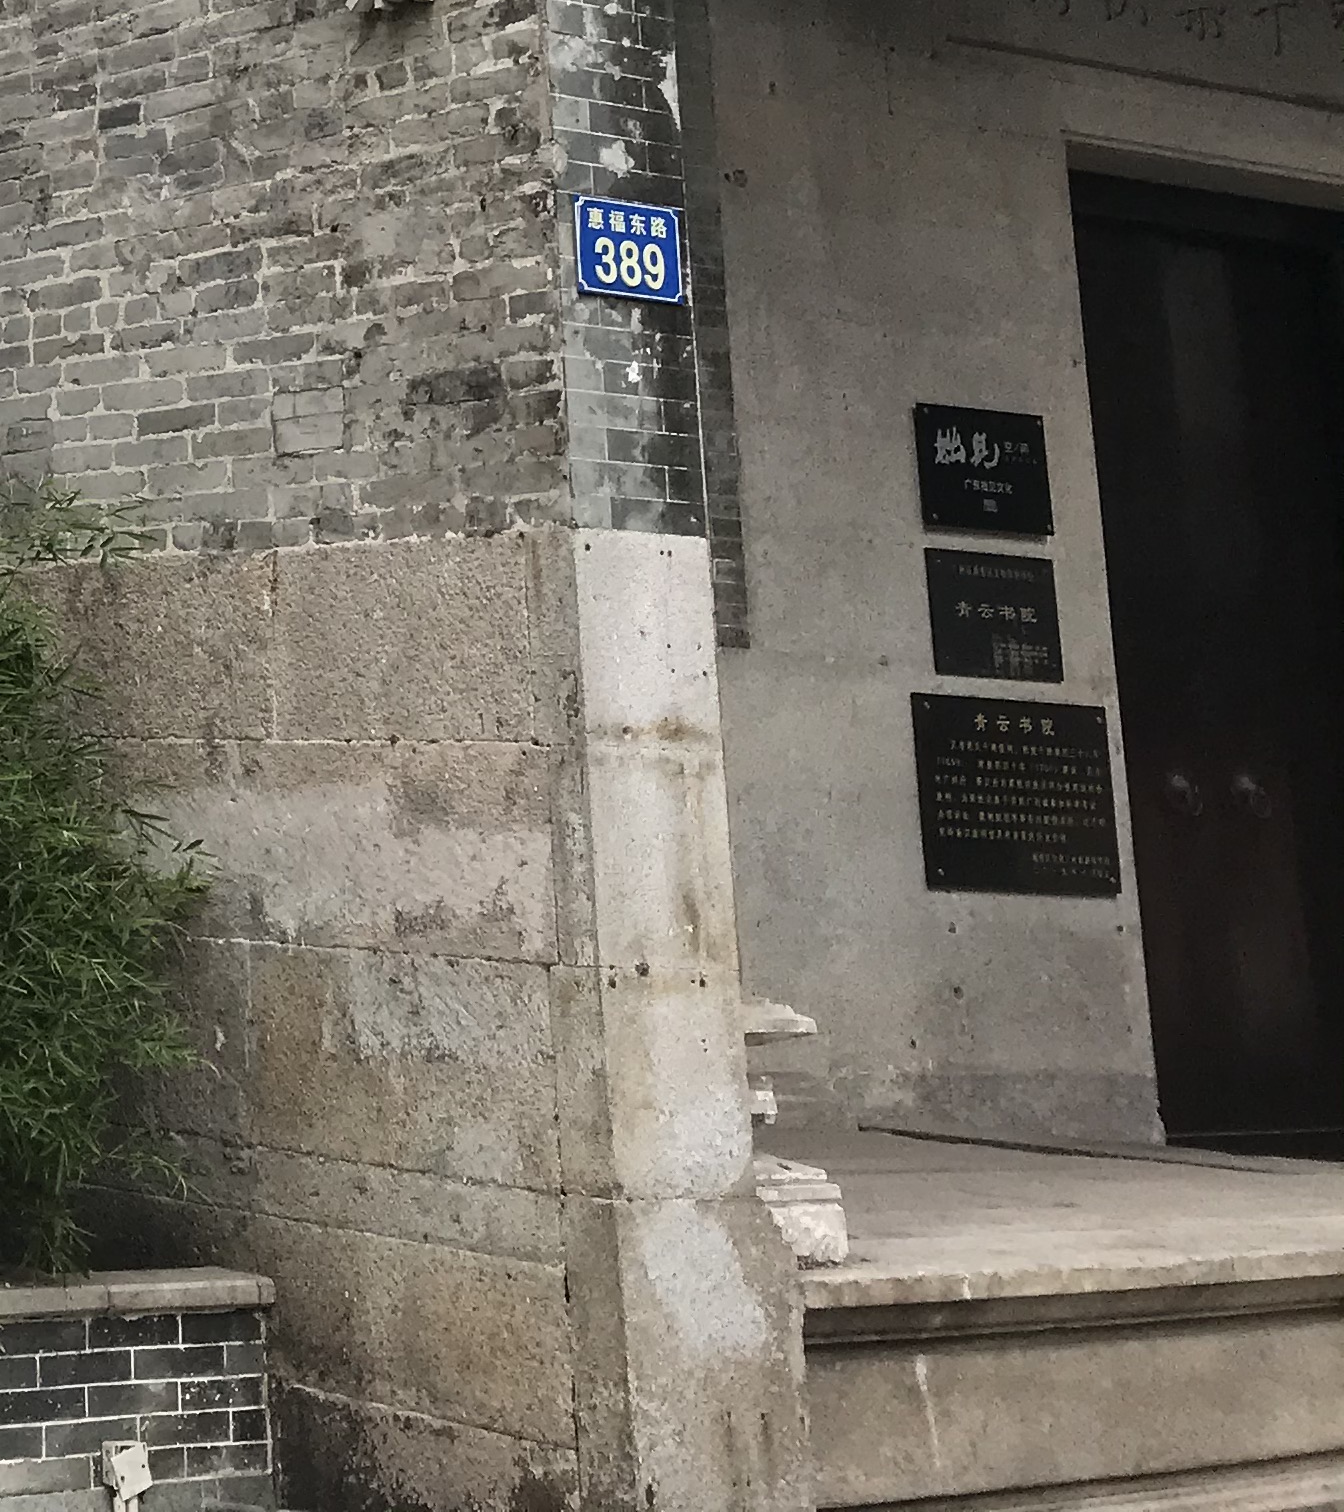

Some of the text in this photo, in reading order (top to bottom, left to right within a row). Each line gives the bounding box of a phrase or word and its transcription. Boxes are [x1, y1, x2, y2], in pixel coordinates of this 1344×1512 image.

[586, 207, 668, 239] 惠福东路
[594, 236, 666, 290] 389
[954, 599, 1039, 624] 青云书院
[973, 712, 1057, 737] 青云书院
